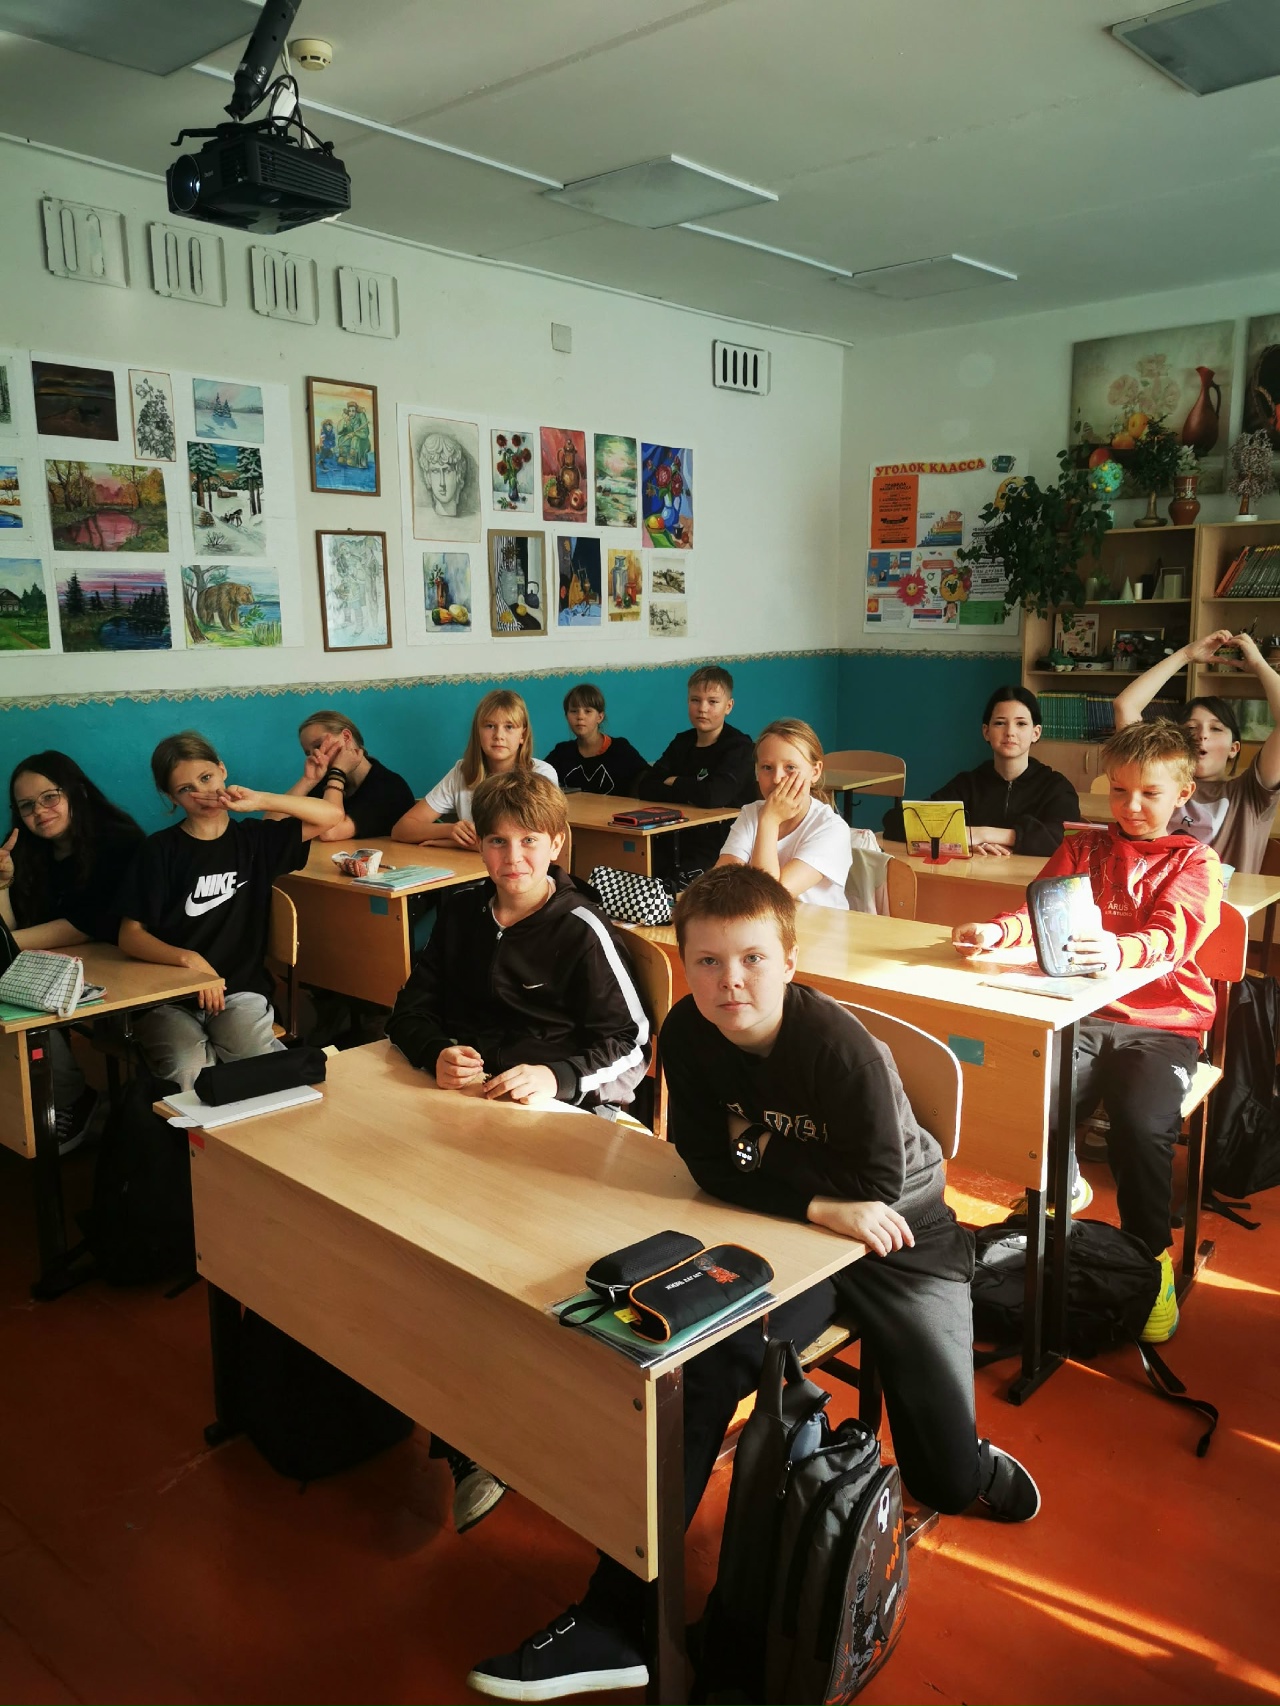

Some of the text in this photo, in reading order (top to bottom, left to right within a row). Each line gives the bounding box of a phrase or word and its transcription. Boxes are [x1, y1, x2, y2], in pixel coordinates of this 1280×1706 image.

[875, 463, 925, 476] УГОЛОК
[929, 458, 985, 473] КЛАССА
[193, 871, 238, 899] NIKE
